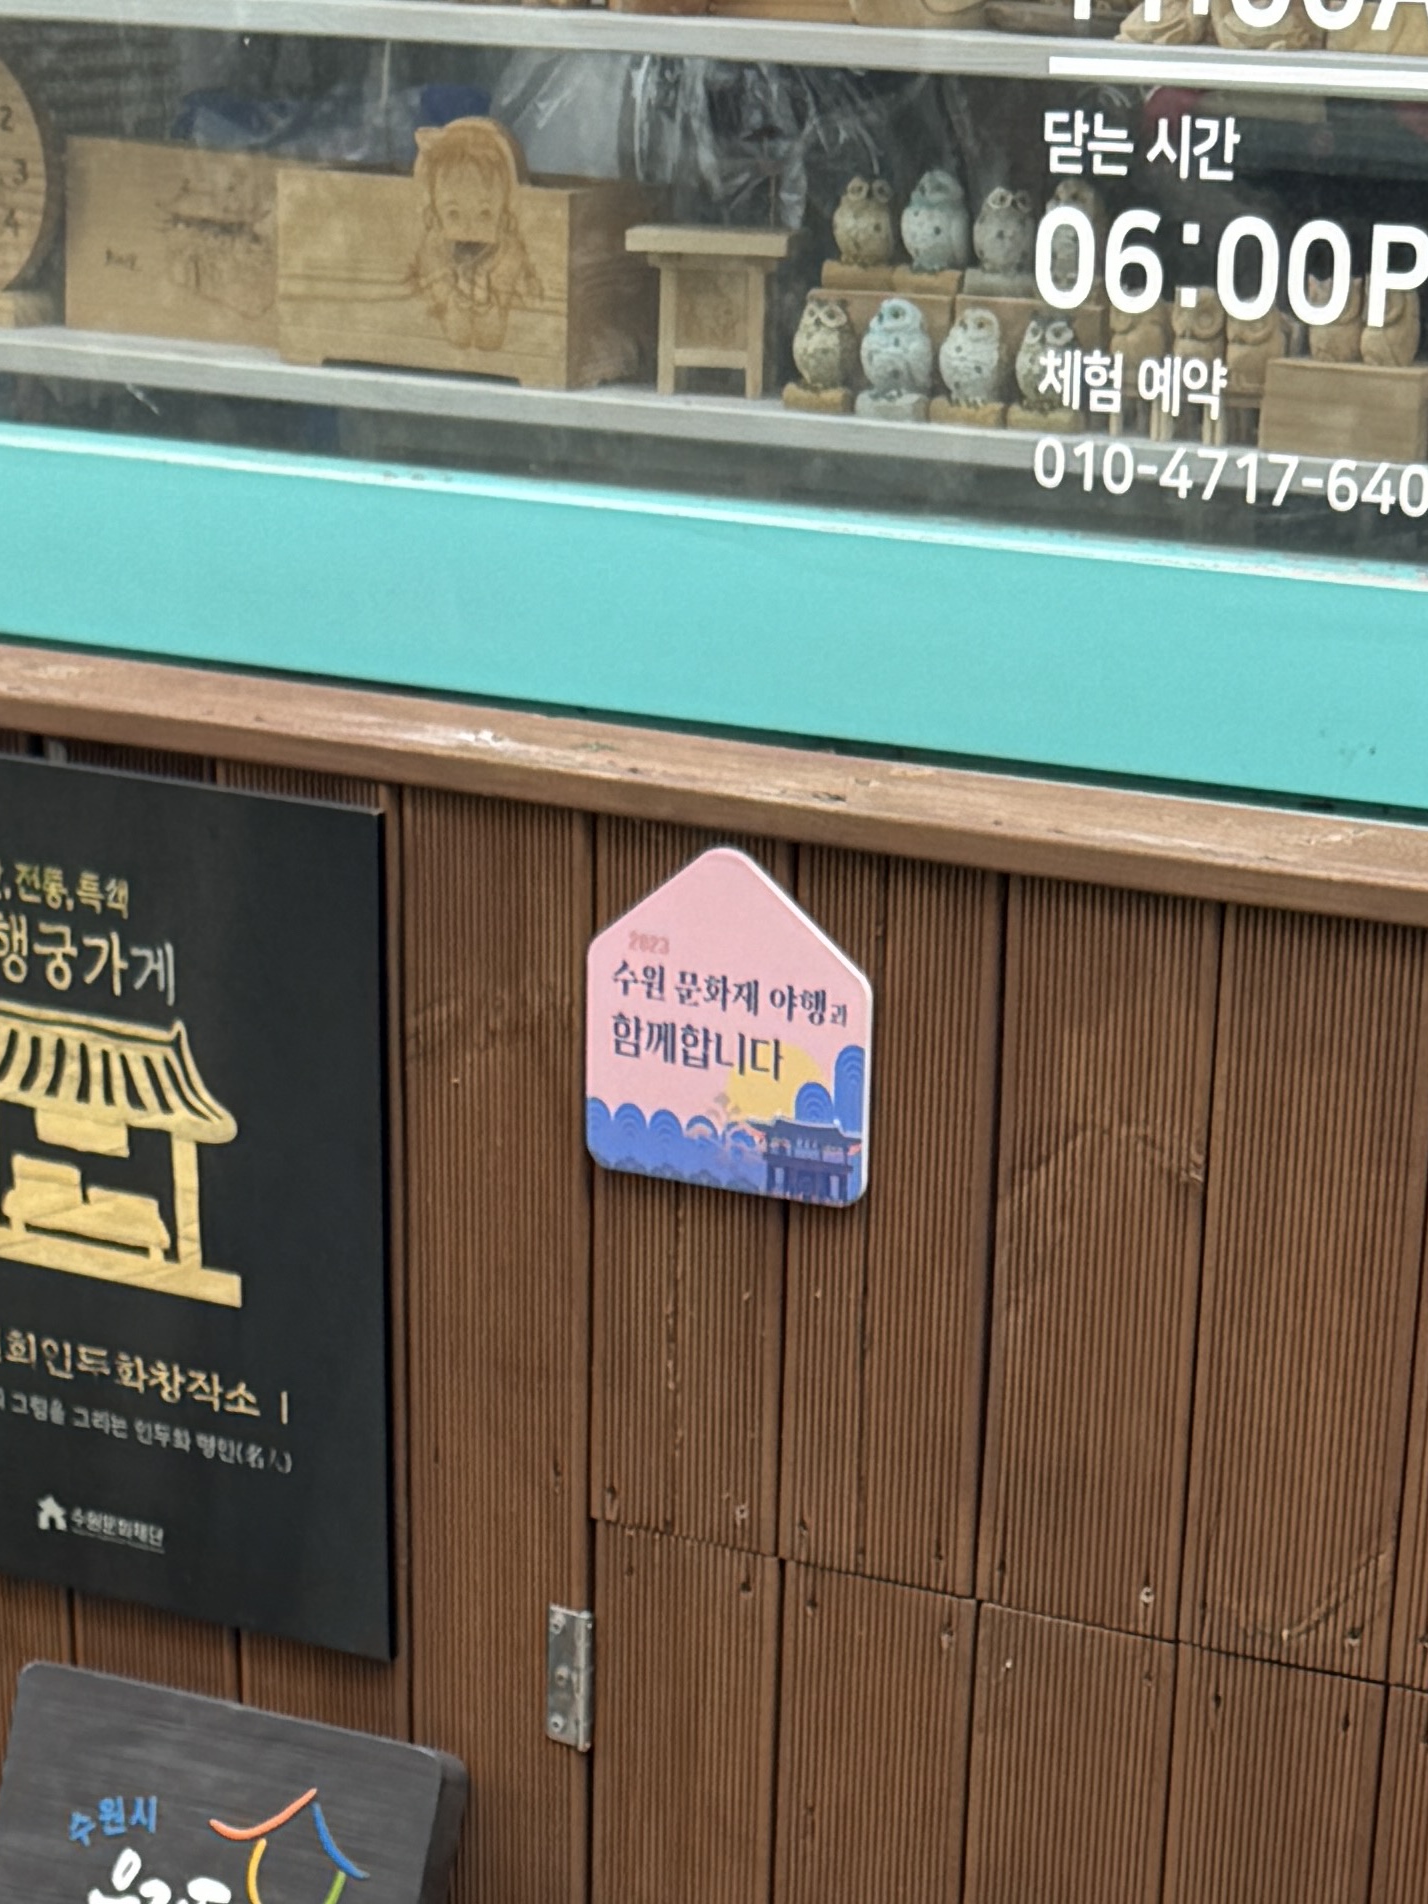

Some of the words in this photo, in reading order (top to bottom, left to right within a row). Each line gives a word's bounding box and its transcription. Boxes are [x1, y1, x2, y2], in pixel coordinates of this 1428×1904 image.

[0, 105, 14, 132] 2
[1044, 109, 1134, 177] 닫는
[1146, 115, 1241, 182] 시간
[13, 158, 28, 185] 3
[4, 209, 19, 236] 4
[1037, 350, 1123, 415] 체험
[1138, 356, 1228, 420] 예약
[612, 959, 667, 1003] 수원
[674, 967, 760, 1017] 문화재
[769, 984, 848, 1029] 야행과
[613, 1010, 784, 1082] 함께합니다
[68, 1795, 159, 1847] 수원시
